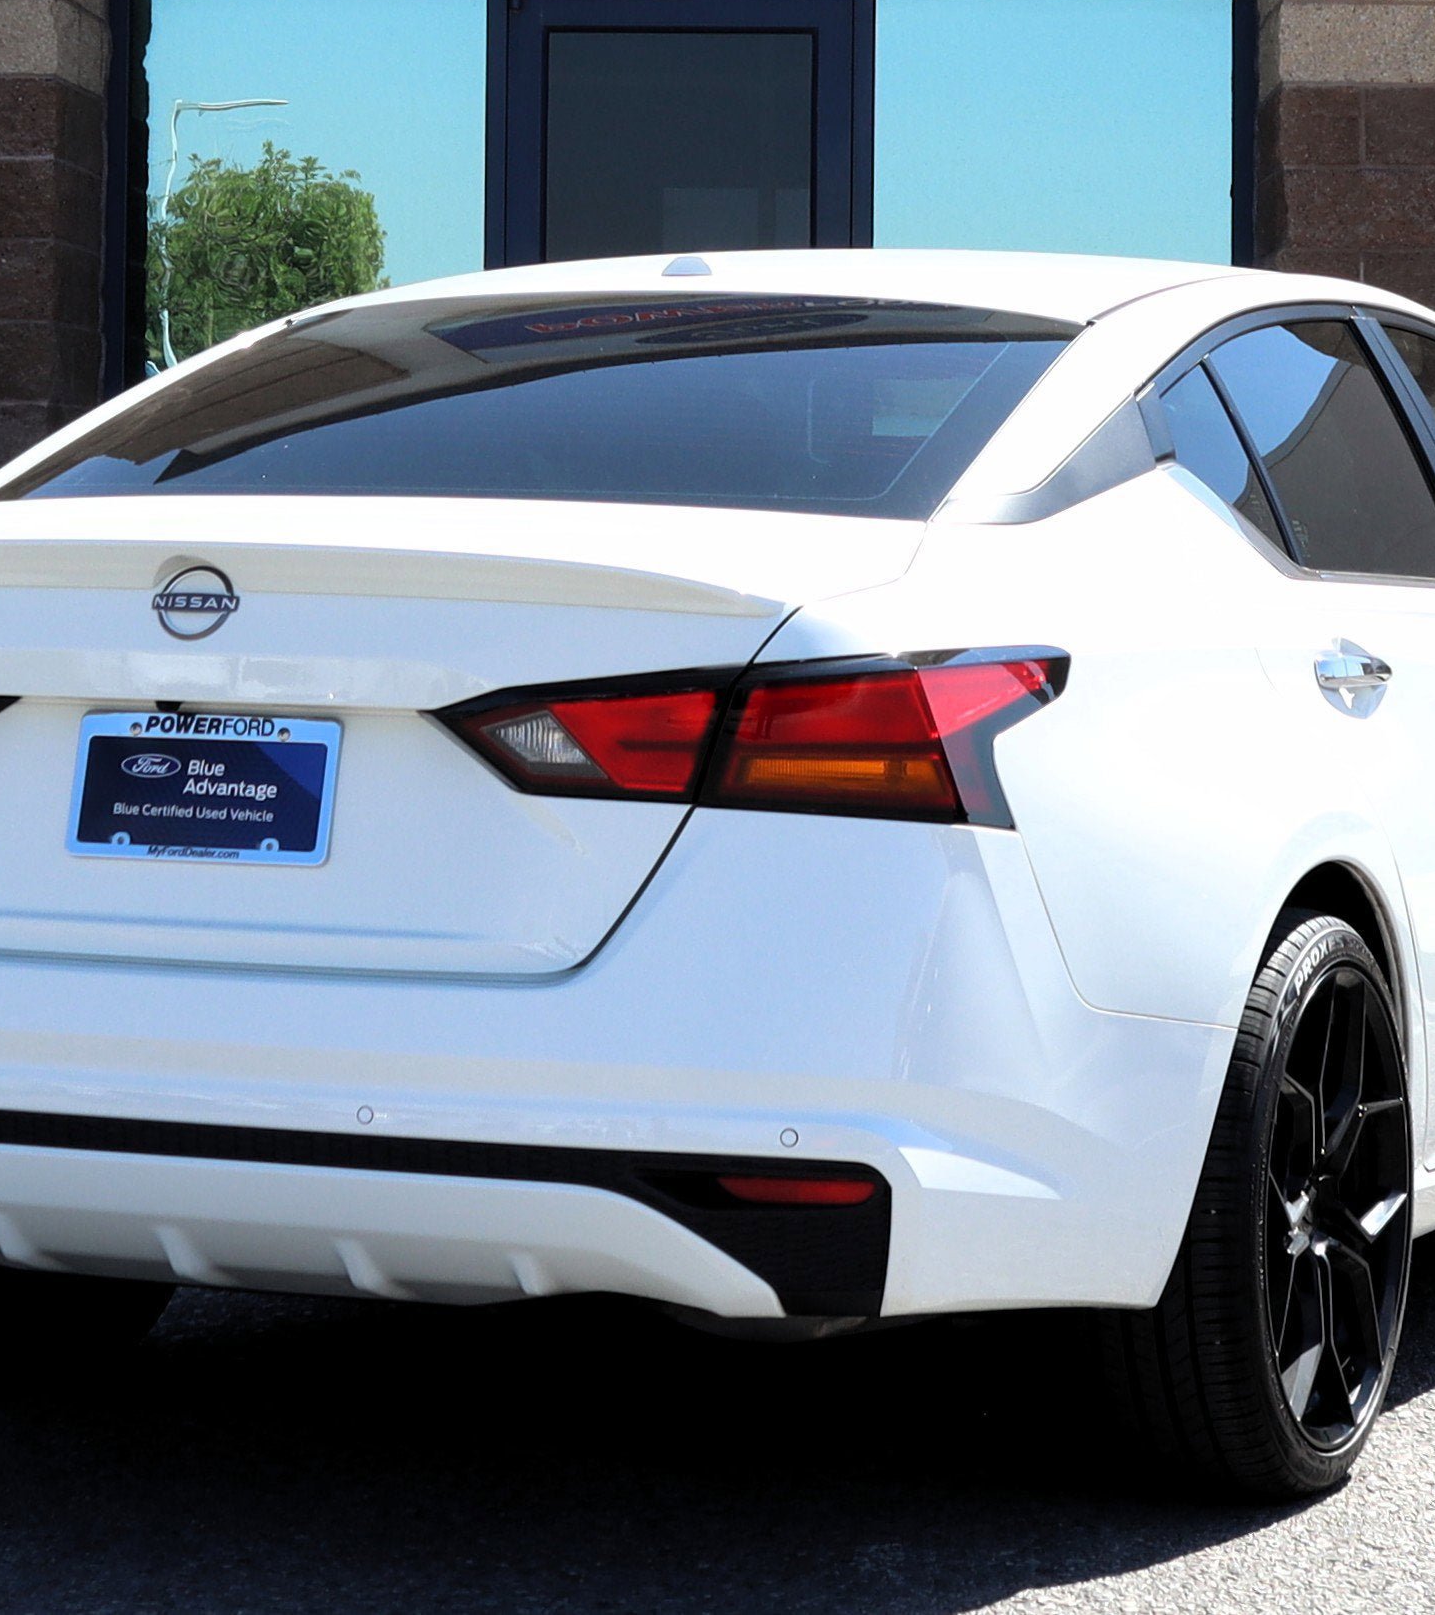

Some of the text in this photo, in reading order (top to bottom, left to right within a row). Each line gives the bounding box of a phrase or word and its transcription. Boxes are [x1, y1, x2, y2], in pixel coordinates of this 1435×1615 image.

[153, 594, 238, 610] NISSAN
[144, 715, 276, 737] POWERFORD
[131, 756, 170, 775] Ford
[187, 760, 226, 777] Blue
[182, 778, 278, 801] Advantage
[113, 802, 275, 823] Blue Certified Used Vehicle
[1293, 934, 1346, 996] PROXES
